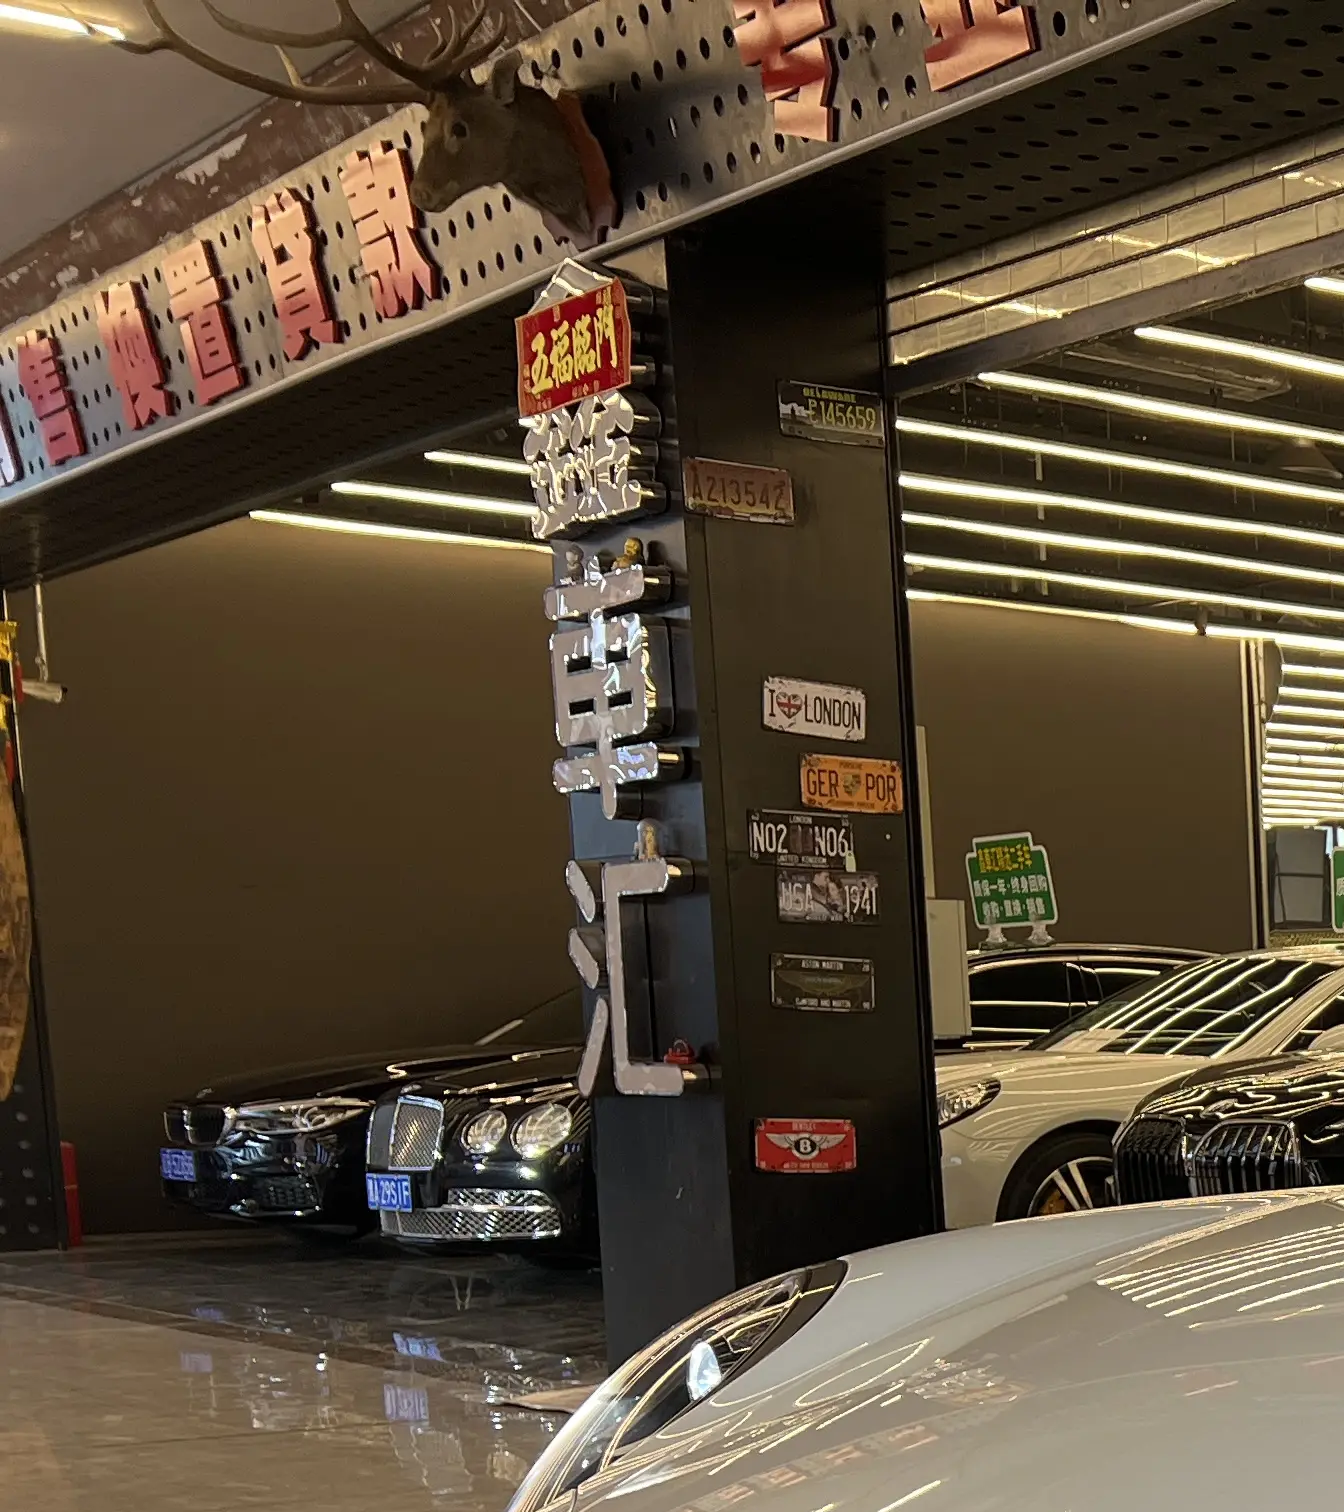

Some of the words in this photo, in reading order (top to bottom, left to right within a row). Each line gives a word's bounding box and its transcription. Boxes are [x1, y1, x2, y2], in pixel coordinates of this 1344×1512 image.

[769, 689, 775, 717] I
[805, 694, 861, 730] LONDON
[807, 768, 839, 798] GER
[865, 773, 897, 802] POR
[781, 882, 814, 911] USA
[844, 884, 878, 915] 1941
